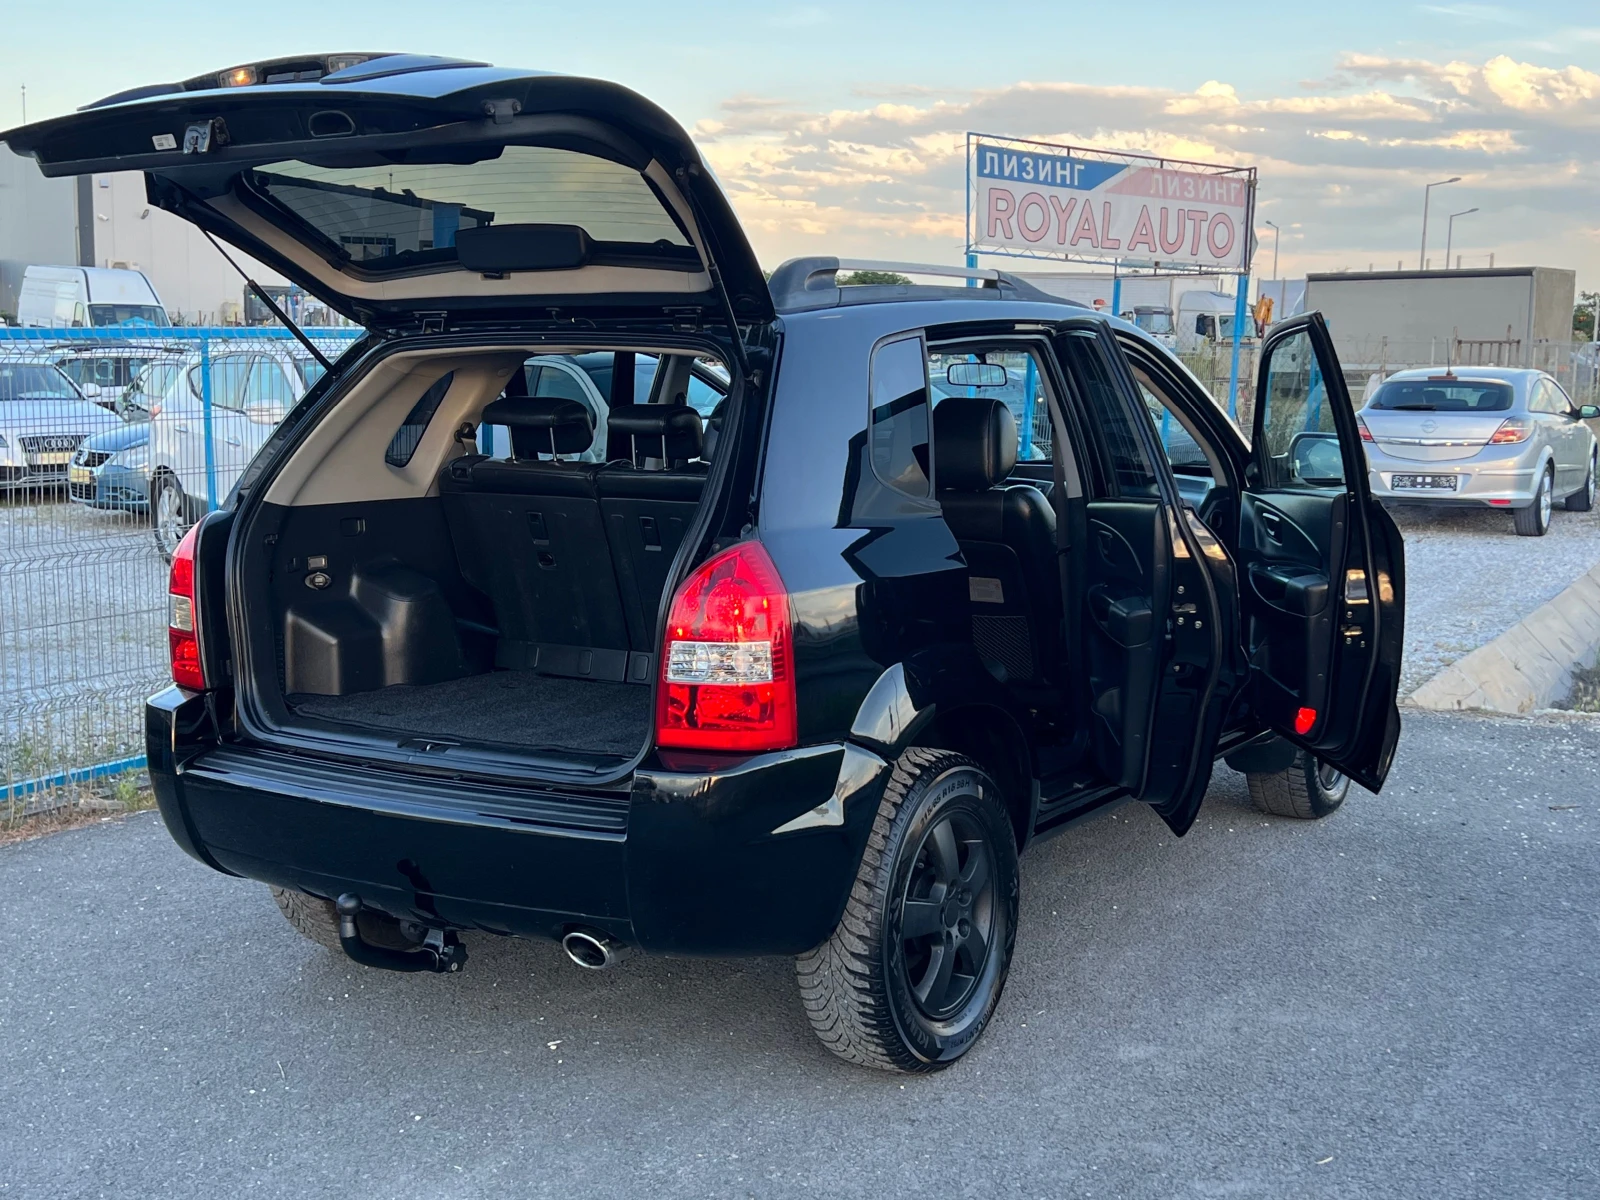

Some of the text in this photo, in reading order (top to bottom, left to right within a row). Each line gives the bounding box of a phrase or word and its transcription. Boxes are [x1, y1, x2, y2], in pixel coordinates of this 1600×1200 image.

[984, 151, 1085, 186] ЛИЗИНГ
[1151, 174, 1241, 203] ЛИЗИНГ
[987, 188, 1235, 258] ROYAL AUTO
